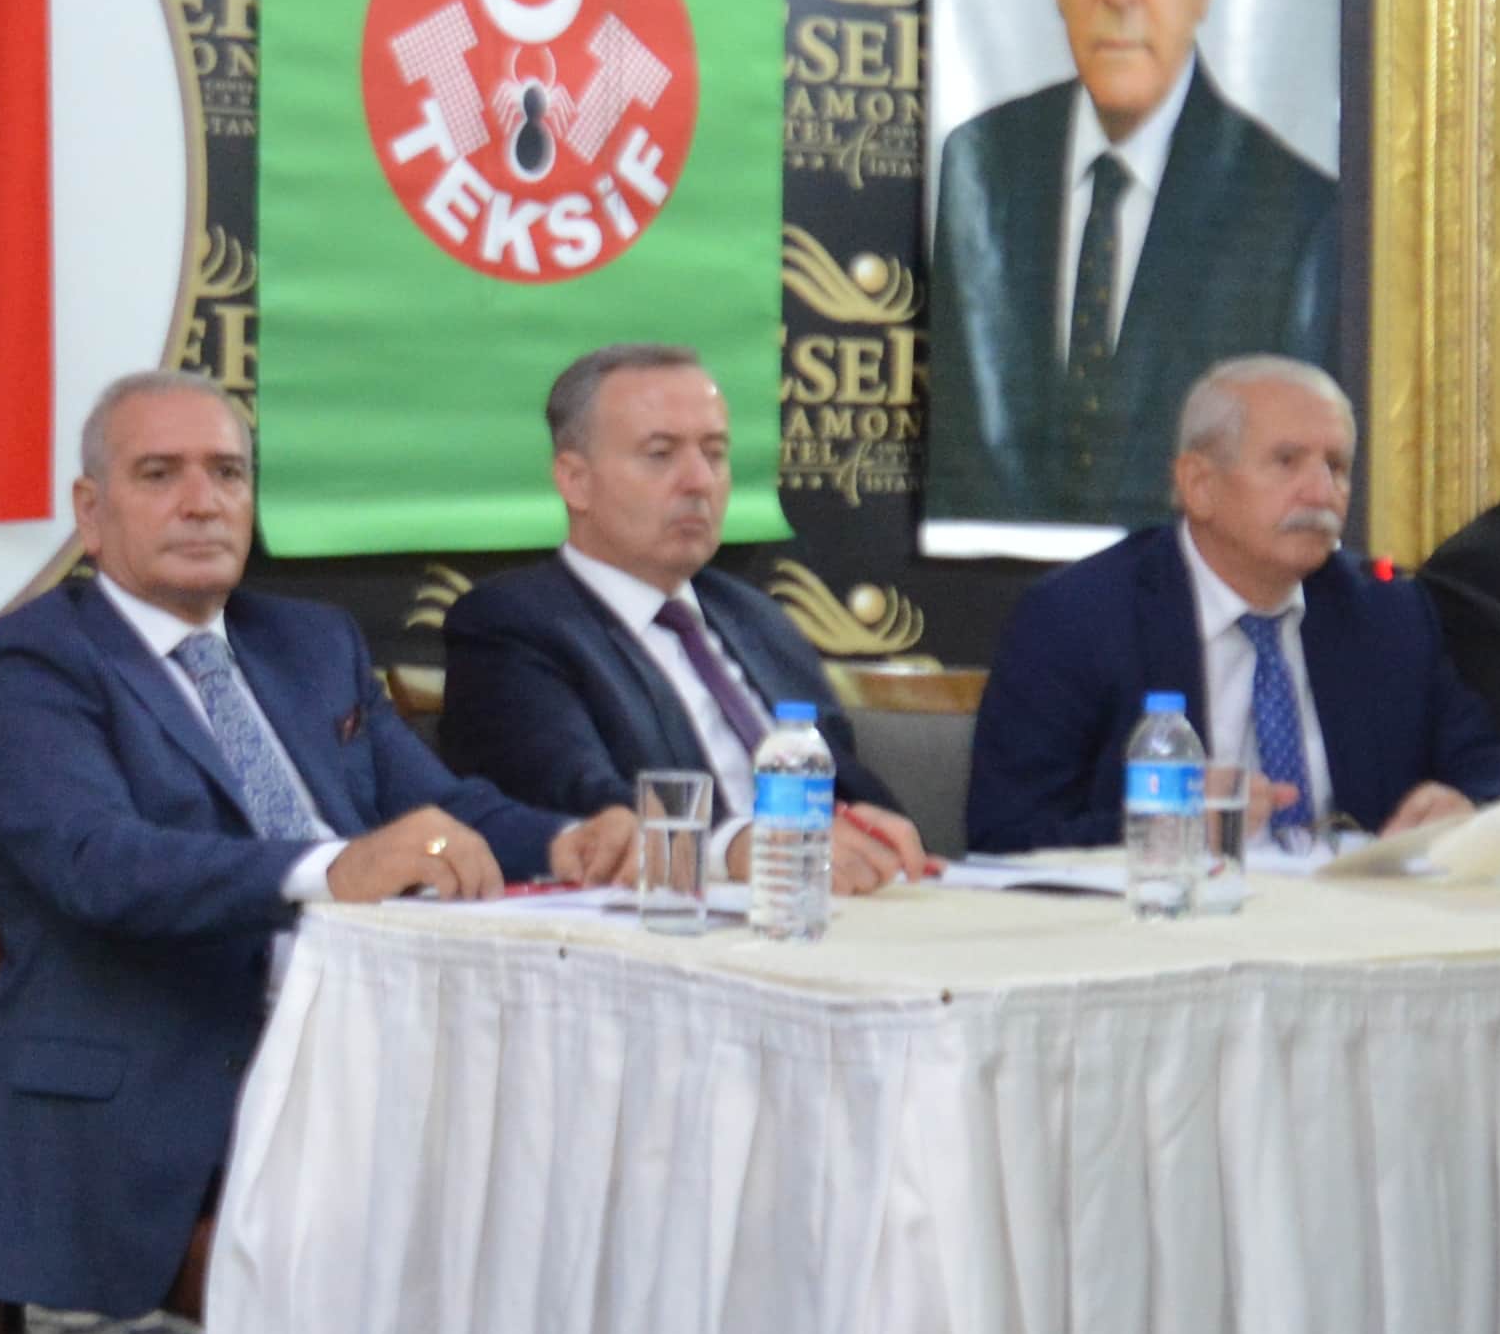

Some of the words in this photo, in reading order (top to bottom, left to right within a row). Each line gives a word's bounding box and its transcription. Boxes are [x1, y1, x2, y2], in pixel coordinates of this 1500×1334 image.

[788, 86, 923, 125] AMON
[786, 119, 842, 149] TEL
[786, 404, 921, 444] AMON
[783, 441, 840, 468] TEL
